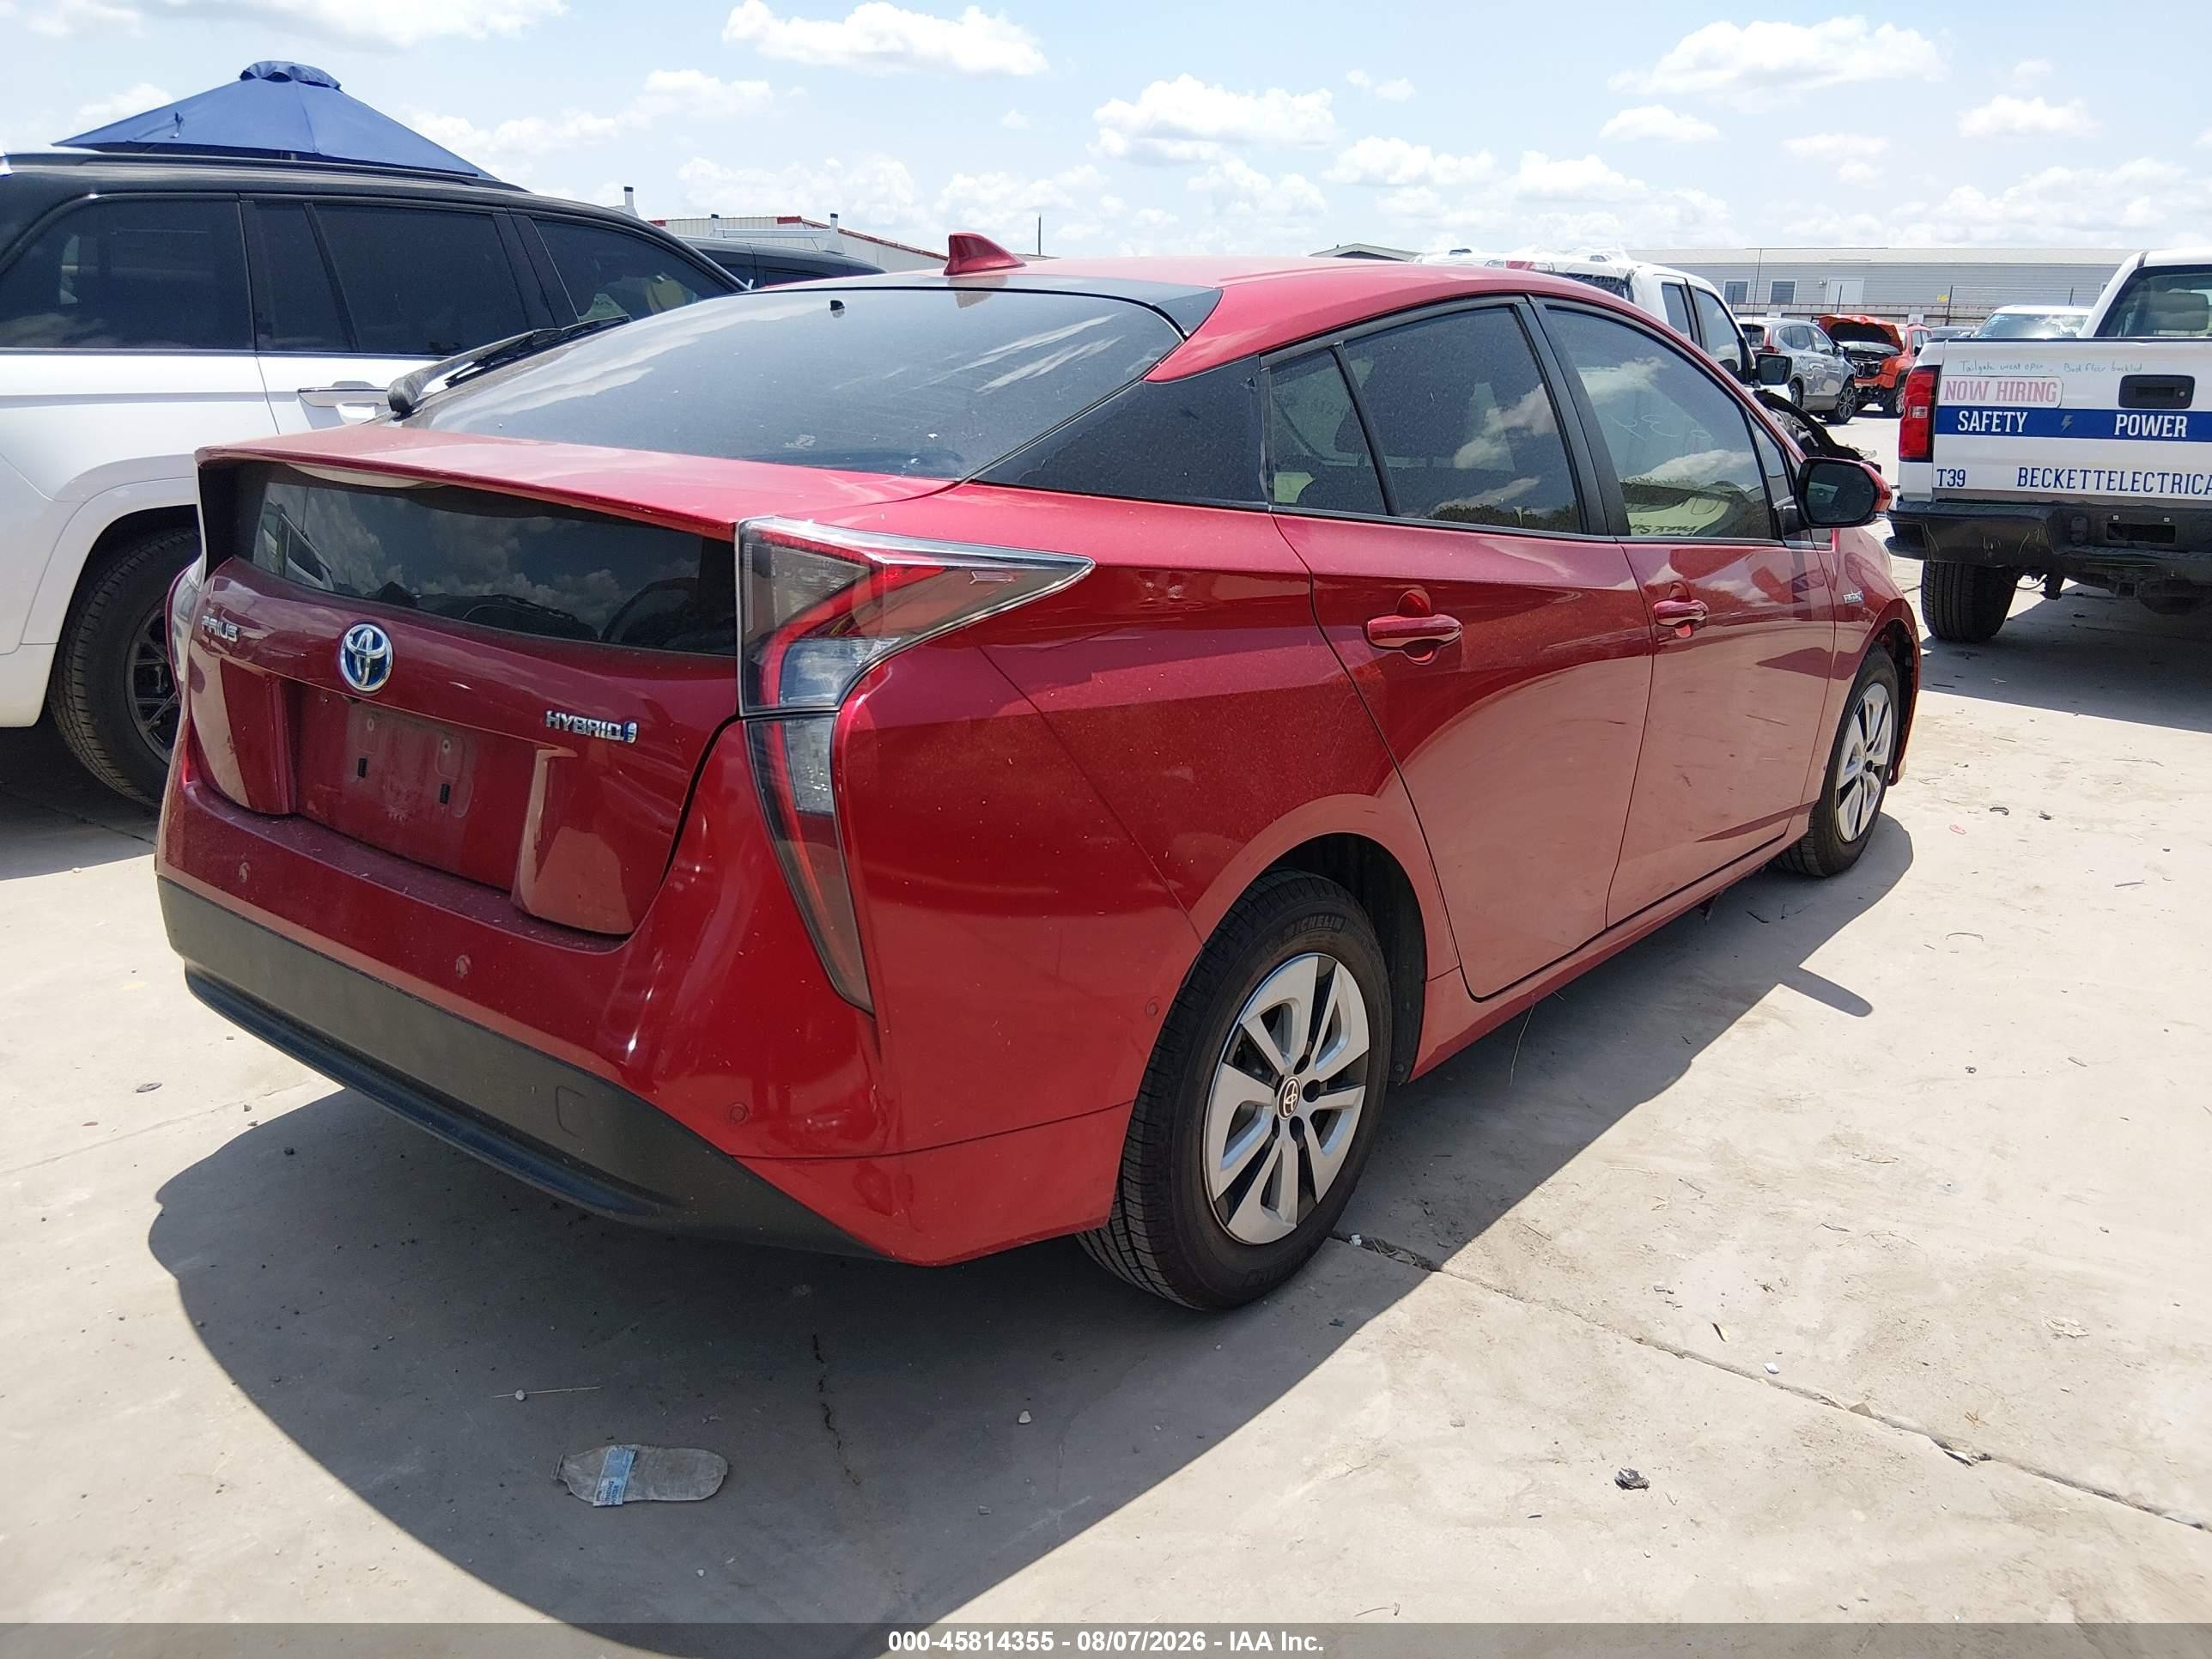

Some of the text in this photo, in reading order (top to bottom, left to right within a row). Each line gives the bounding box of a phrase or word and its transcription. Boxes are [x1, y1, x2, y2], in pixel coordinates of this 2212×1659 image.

[1944, 380, 2057, 403] NOW HIRING
[1957, 410, 2188, 438] SAFETY POWER
[1936, 468, 1966, 487] T39
[201, 615, 238, 643] PRIUS
[545, 709, 624, 741] HYBRID
[1283, 915, 1346, 938] MICHELIN
